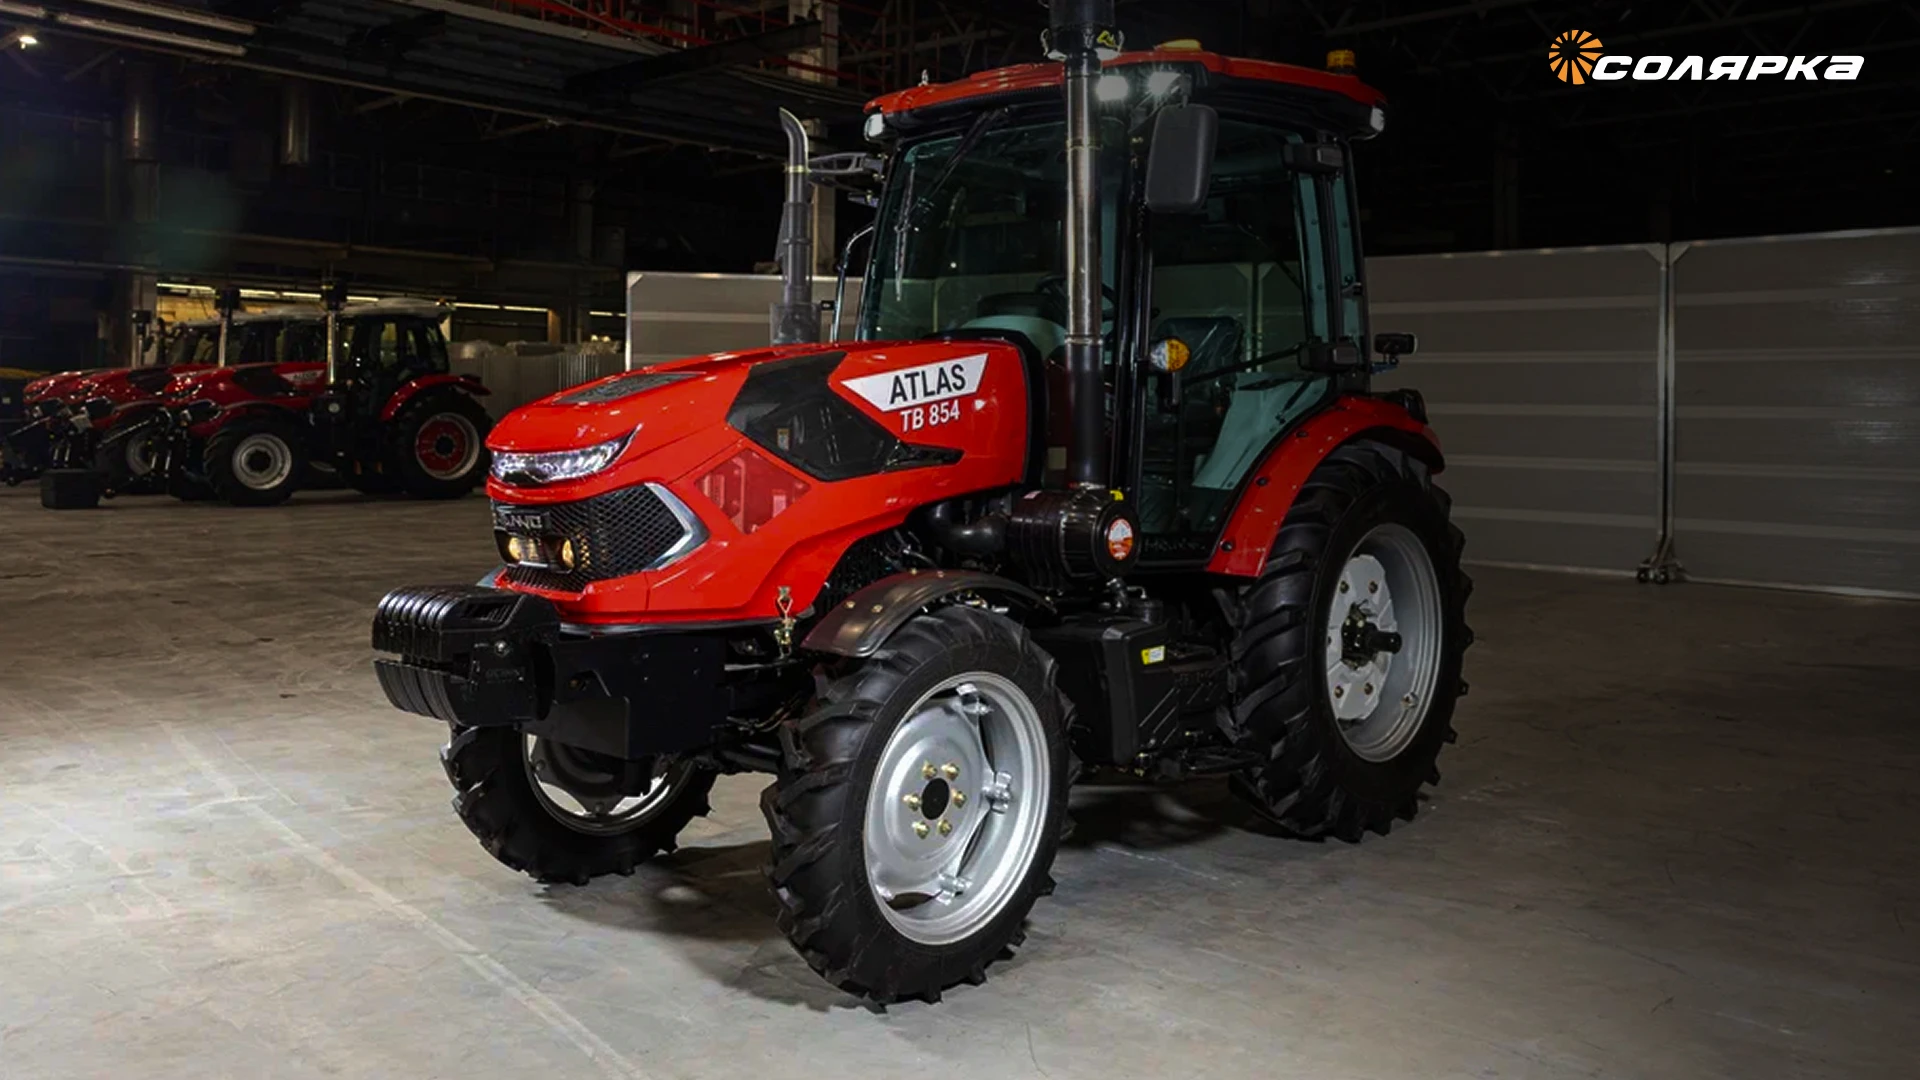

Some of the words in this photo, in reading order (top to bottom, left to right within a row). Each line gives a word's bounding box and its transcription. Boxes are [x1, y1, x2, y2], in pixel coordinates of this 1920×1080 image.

[889, 364, 966, 404] ATLAS
[900, 407, 924, 432] TB
[929, 399, 960, 426] 854
